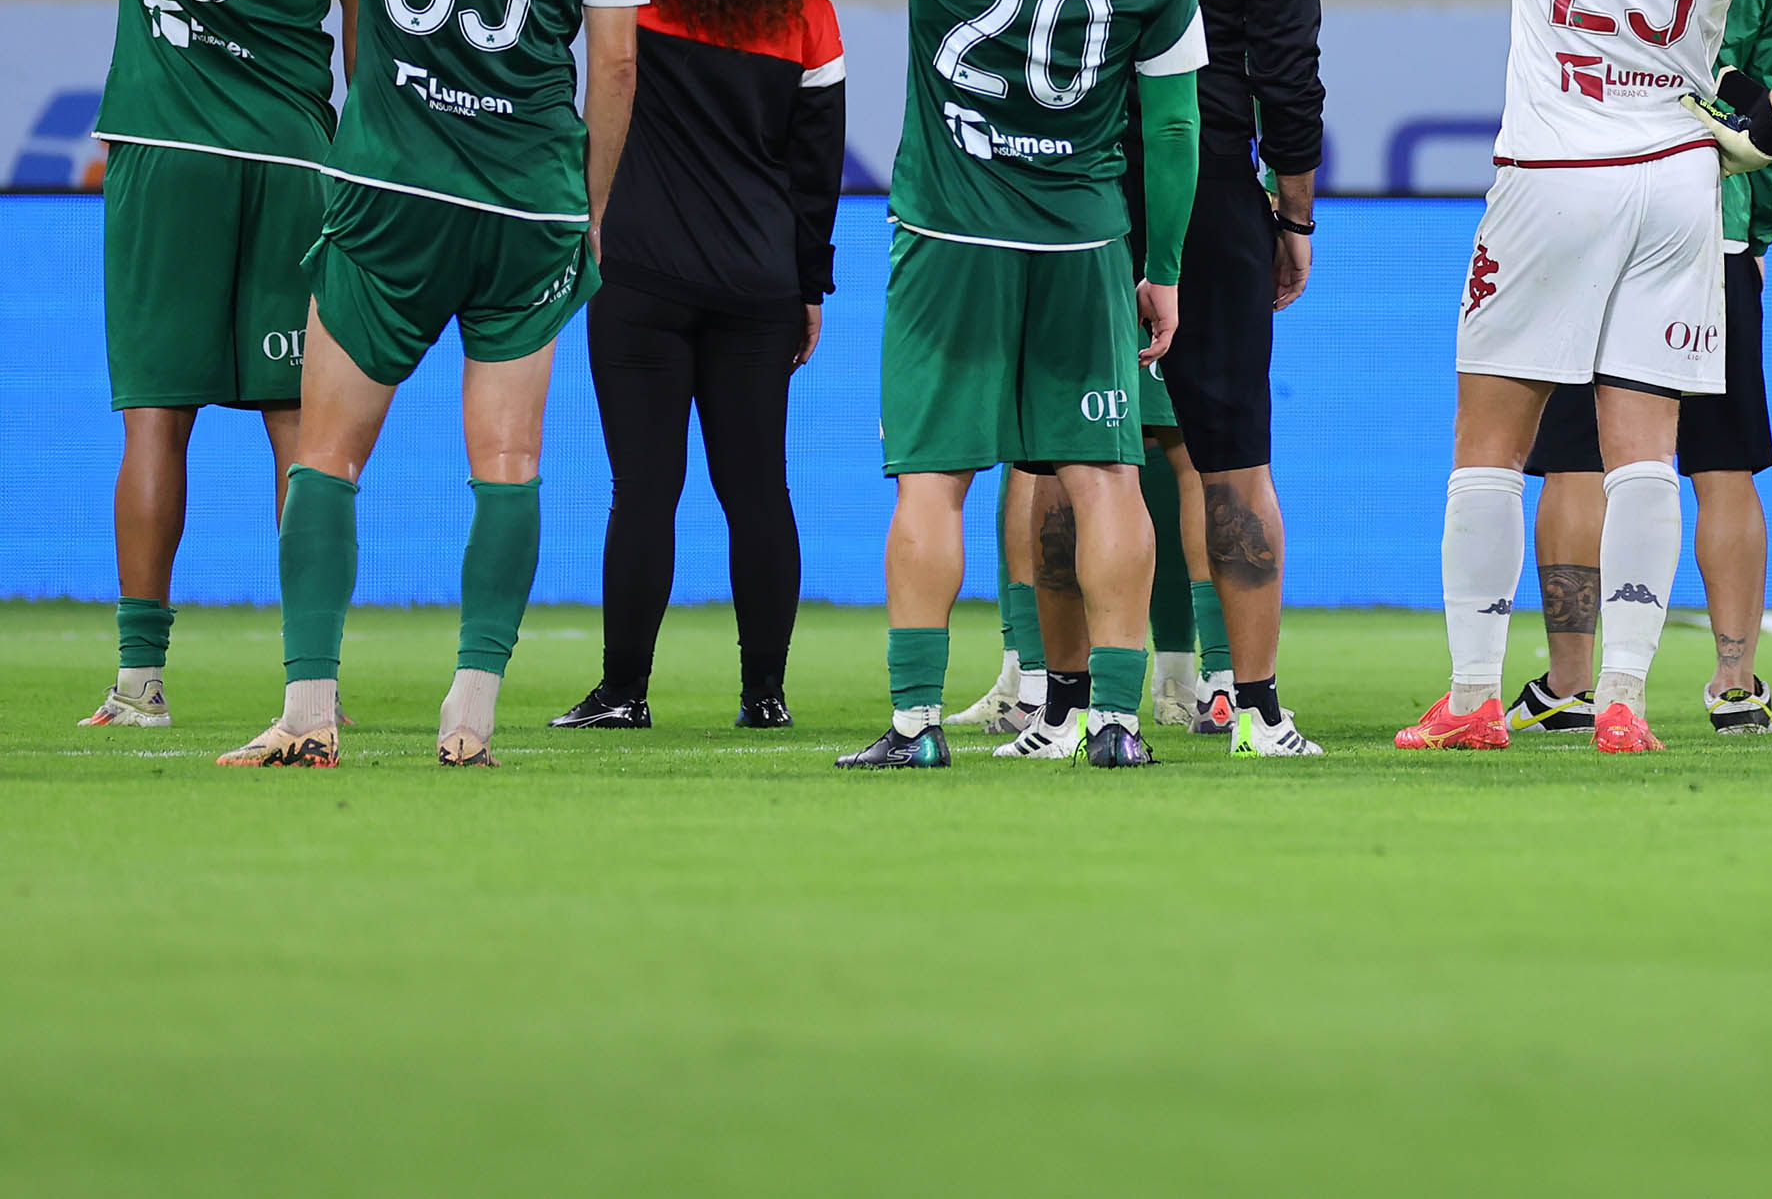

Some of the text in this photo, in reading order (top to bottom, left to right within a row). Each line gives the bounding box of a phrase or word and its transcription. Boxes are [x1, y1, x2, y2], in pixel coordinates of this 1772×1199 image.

[190, 16, 256, 59] Len
[1605, 64, 1684, 88] Lumen
[429, 78, 514, 114] Lumen
[429, 101, 477, 117] INSURANCE
